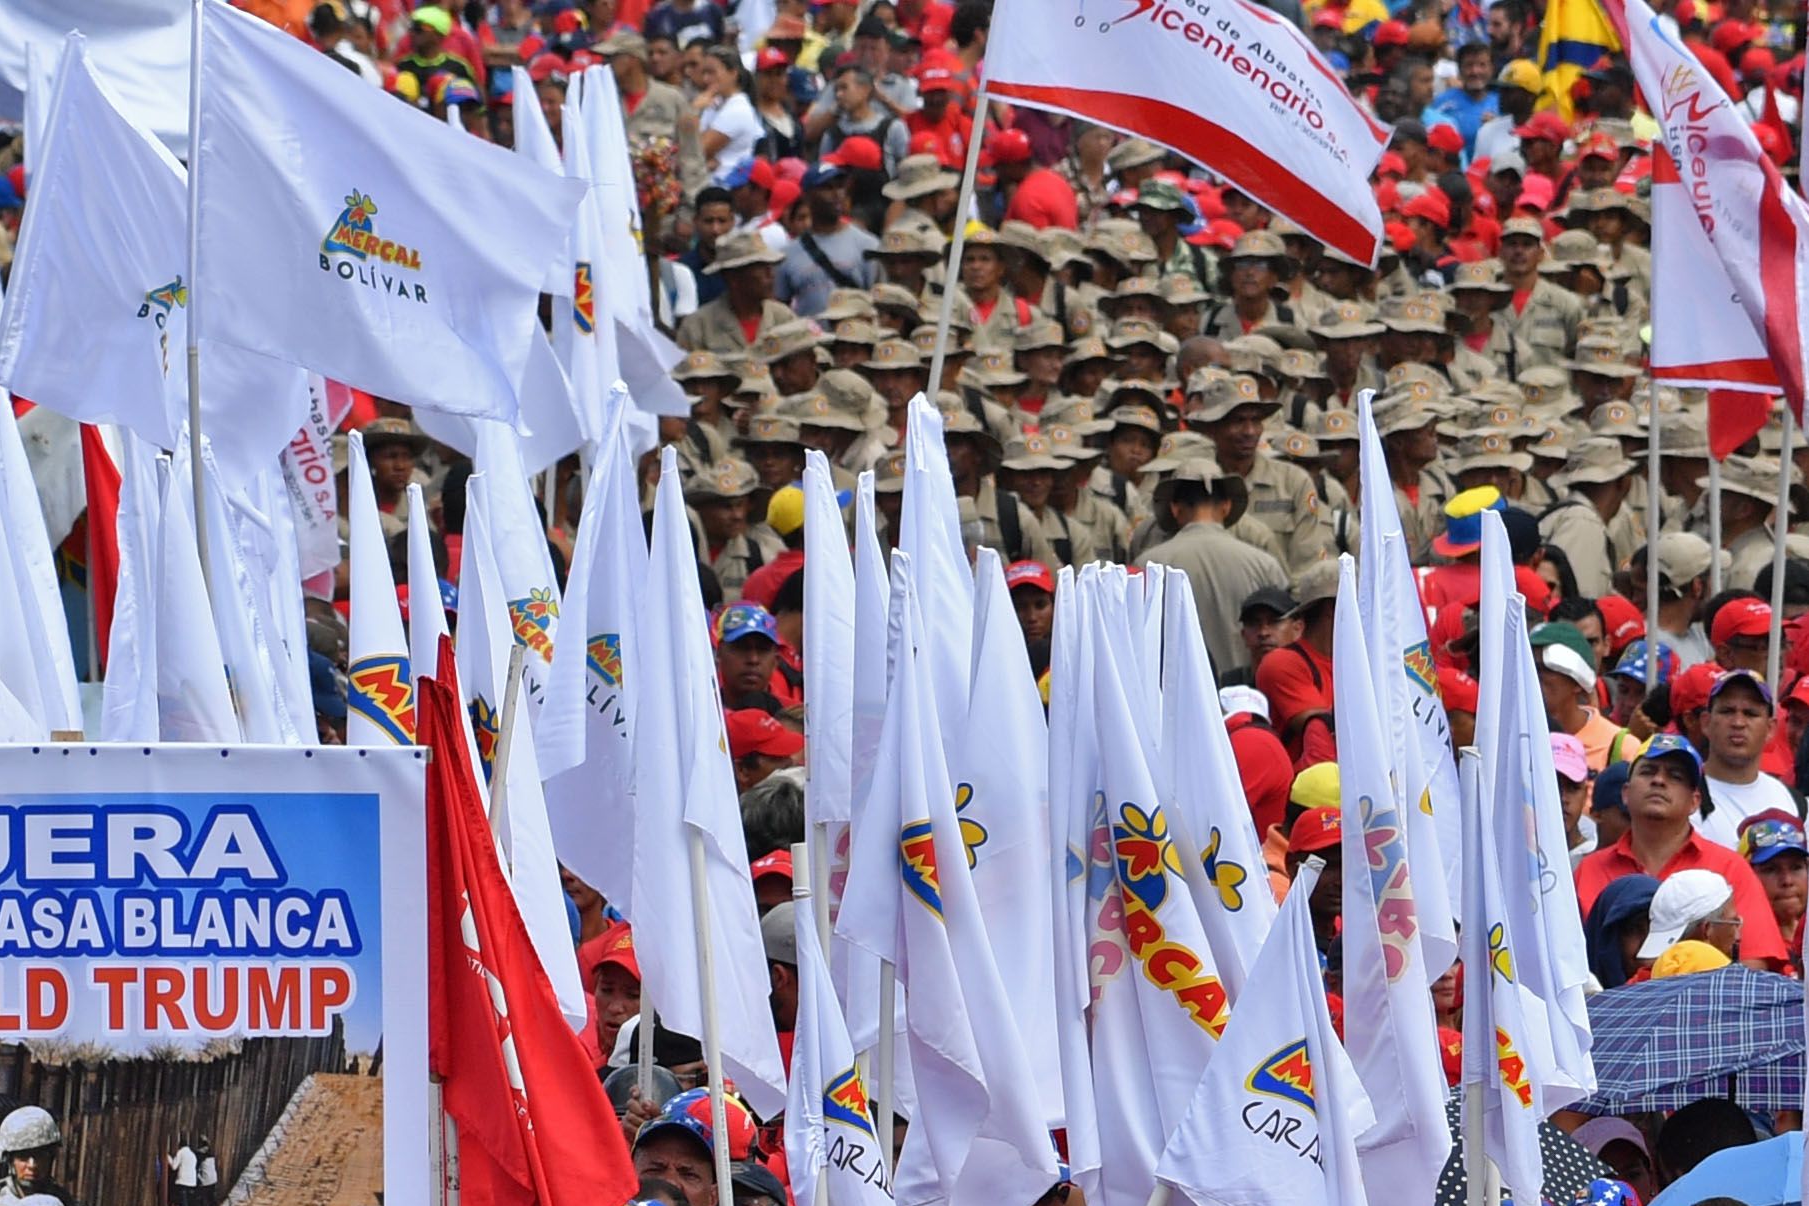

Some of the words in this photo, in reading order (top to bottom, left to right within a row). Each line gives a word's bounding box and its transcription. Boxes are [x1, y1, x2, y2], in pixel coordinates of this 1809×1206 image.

[1216, 19, 1240, 41] de
[1247, 41, 1323, 110] Abastos
[334, 221, 422, 271] MERCAL
[319, 252, 428, 304] BOLÍVAR
[121, 895, 355, 950] BLANCA
[91, 963, 353, 1032] TRUMP
